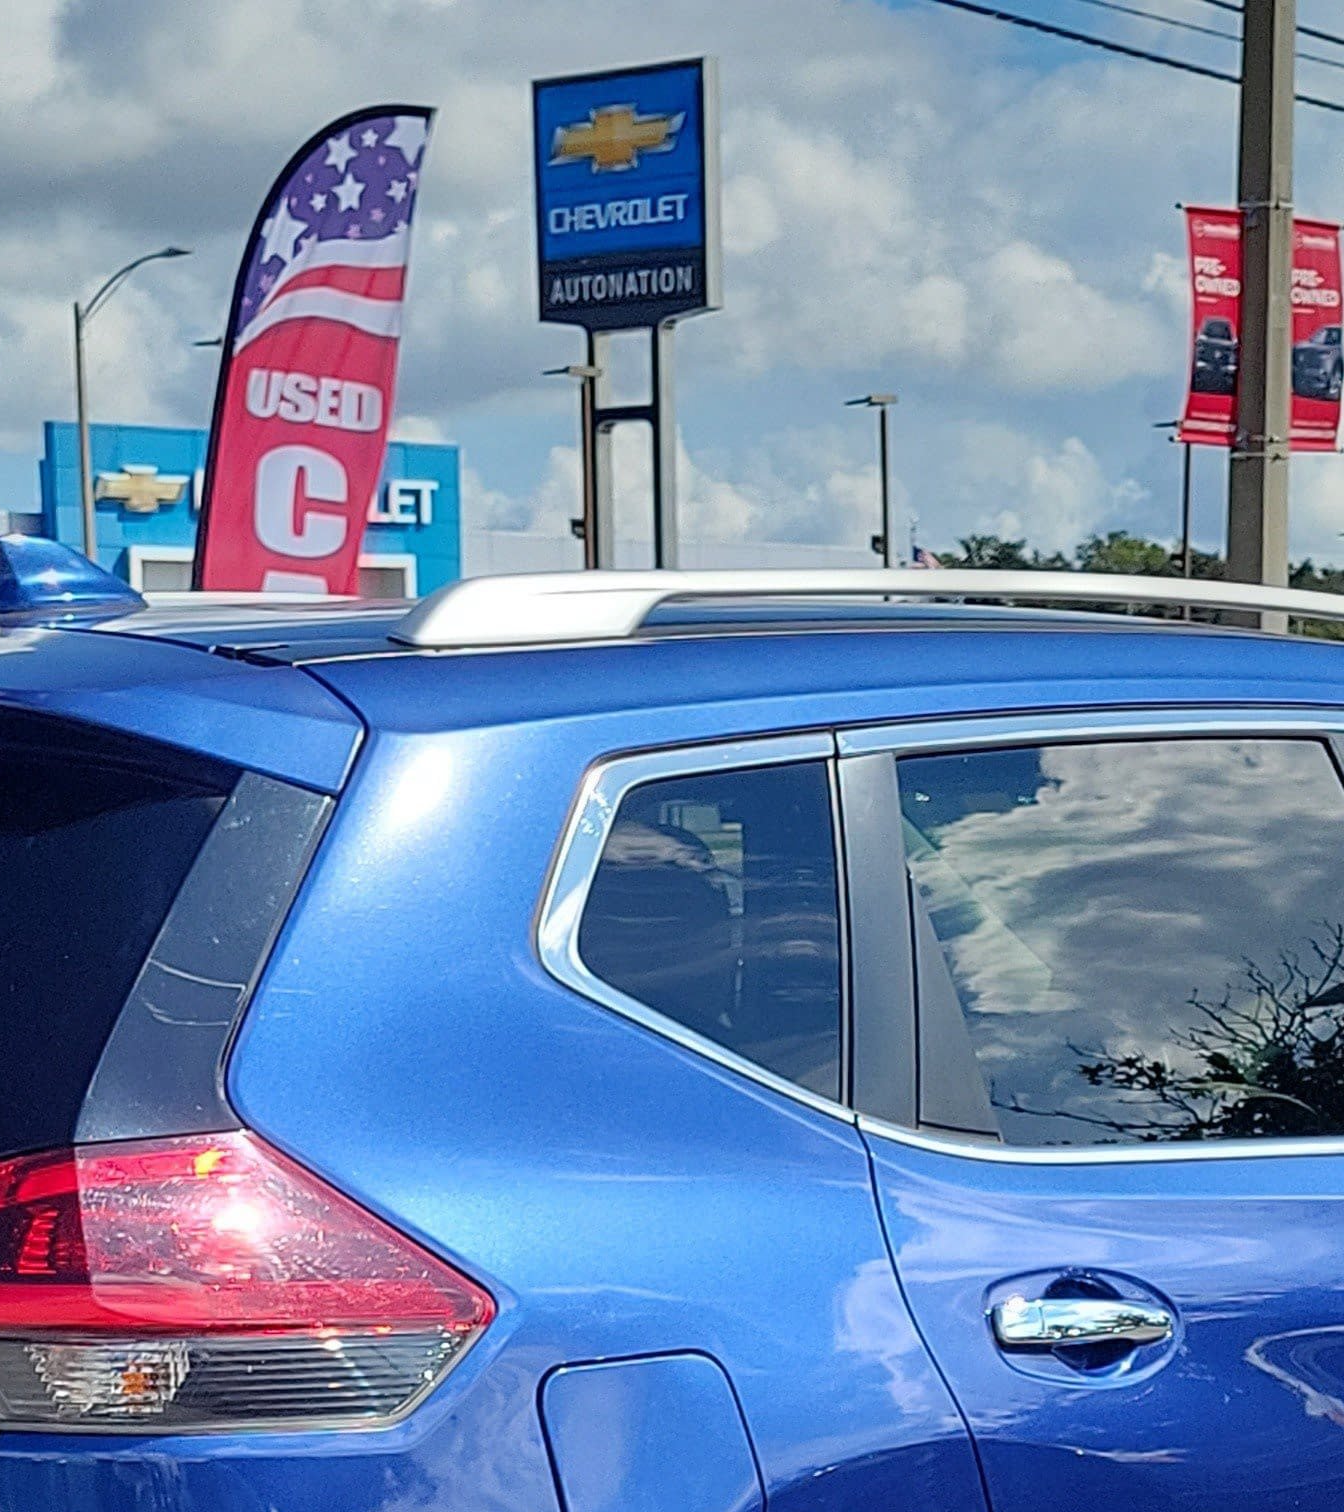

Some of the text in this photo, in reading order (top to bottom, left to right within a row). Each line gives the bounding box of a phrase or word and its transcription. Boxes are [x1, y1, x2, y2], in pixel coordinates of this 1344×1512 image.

[548, 194, 689, 235] CHEVROLET
[550, 263, 694, 303] AUTONATION
[245, 369, 383, 432] USED
